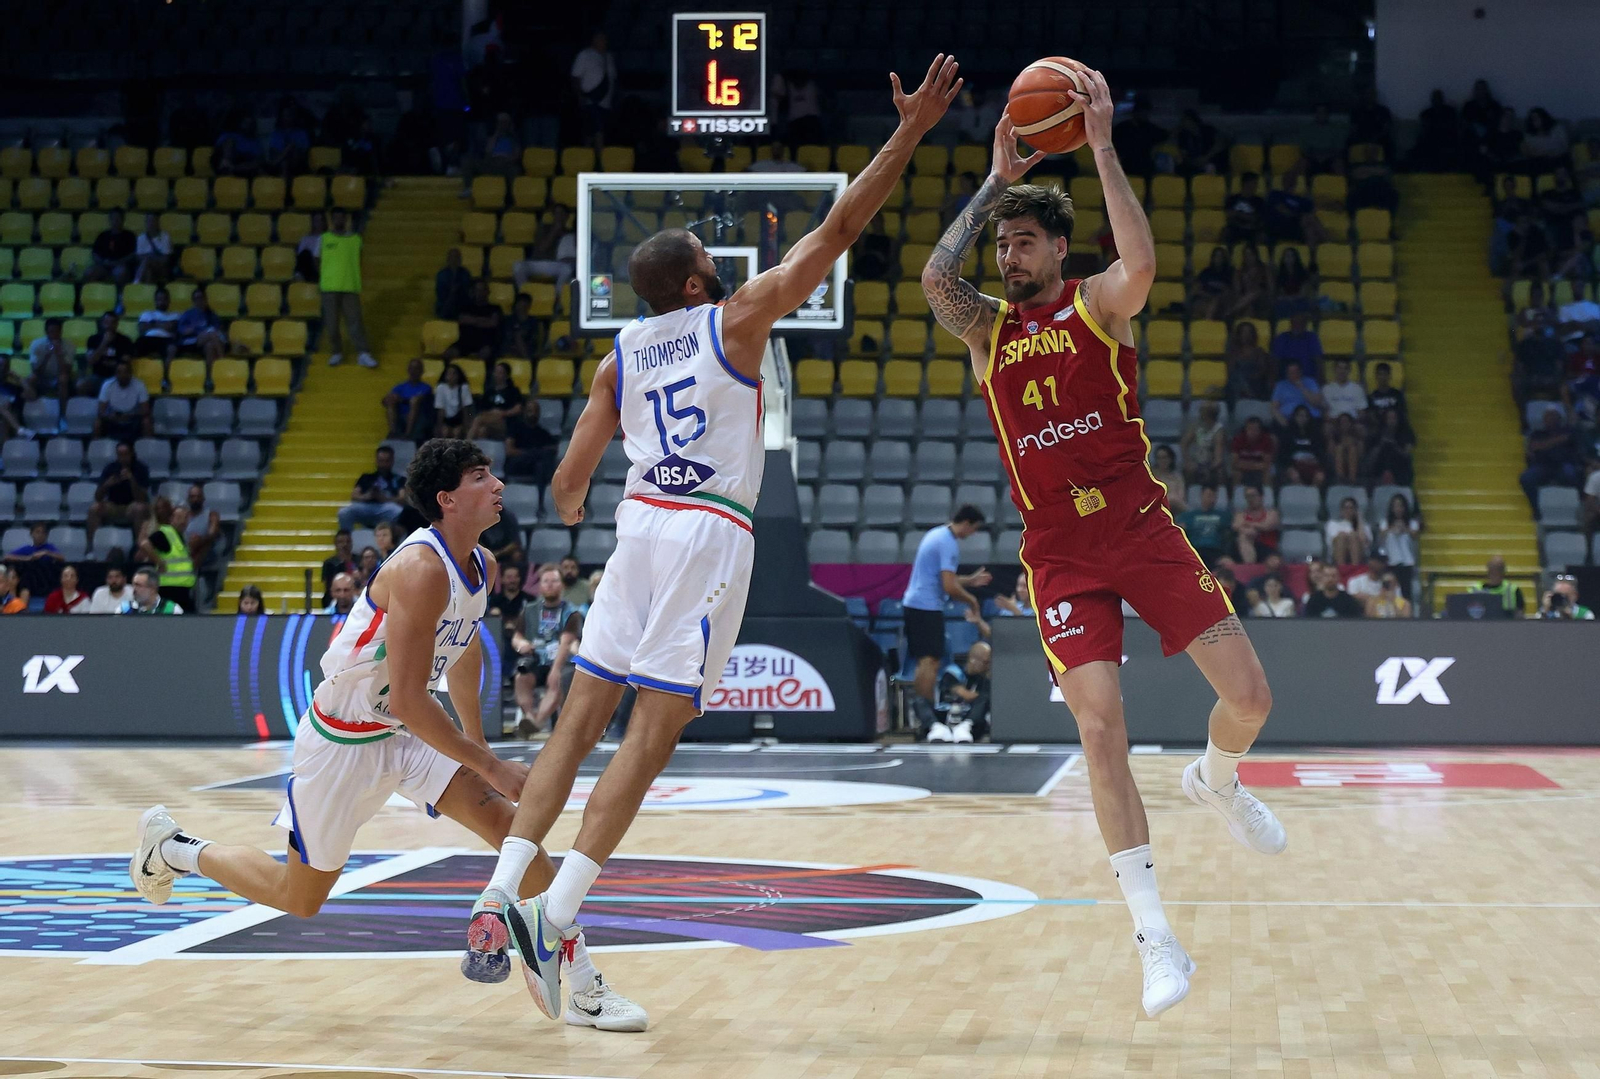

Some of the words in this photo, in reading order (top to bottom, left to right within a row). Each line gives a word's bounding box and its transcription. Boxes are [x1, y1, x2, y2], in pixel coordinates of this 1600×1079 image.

[698, 23, 758, 51] 7:12
[707, 59, 740, 106] 1.6
[697, 117, 768, 133] TISSOT
[633, 332, 700, 373] THOMPSON
[998, 326, 1078, 373] ESPAÑA
[1022, 375, 1060, 411] 41
[644, 375, 707, 457] 15
[1016, 410, 1104, 457] endesa
[653, 465, 702, 486] IBSA
[1049, 625, 1084, 644] tenerife!
[22, 654, 85, 694] 1X
[722, 656, 795, 678] 百岁山
[1374, 656, 1456, 705] 1X
